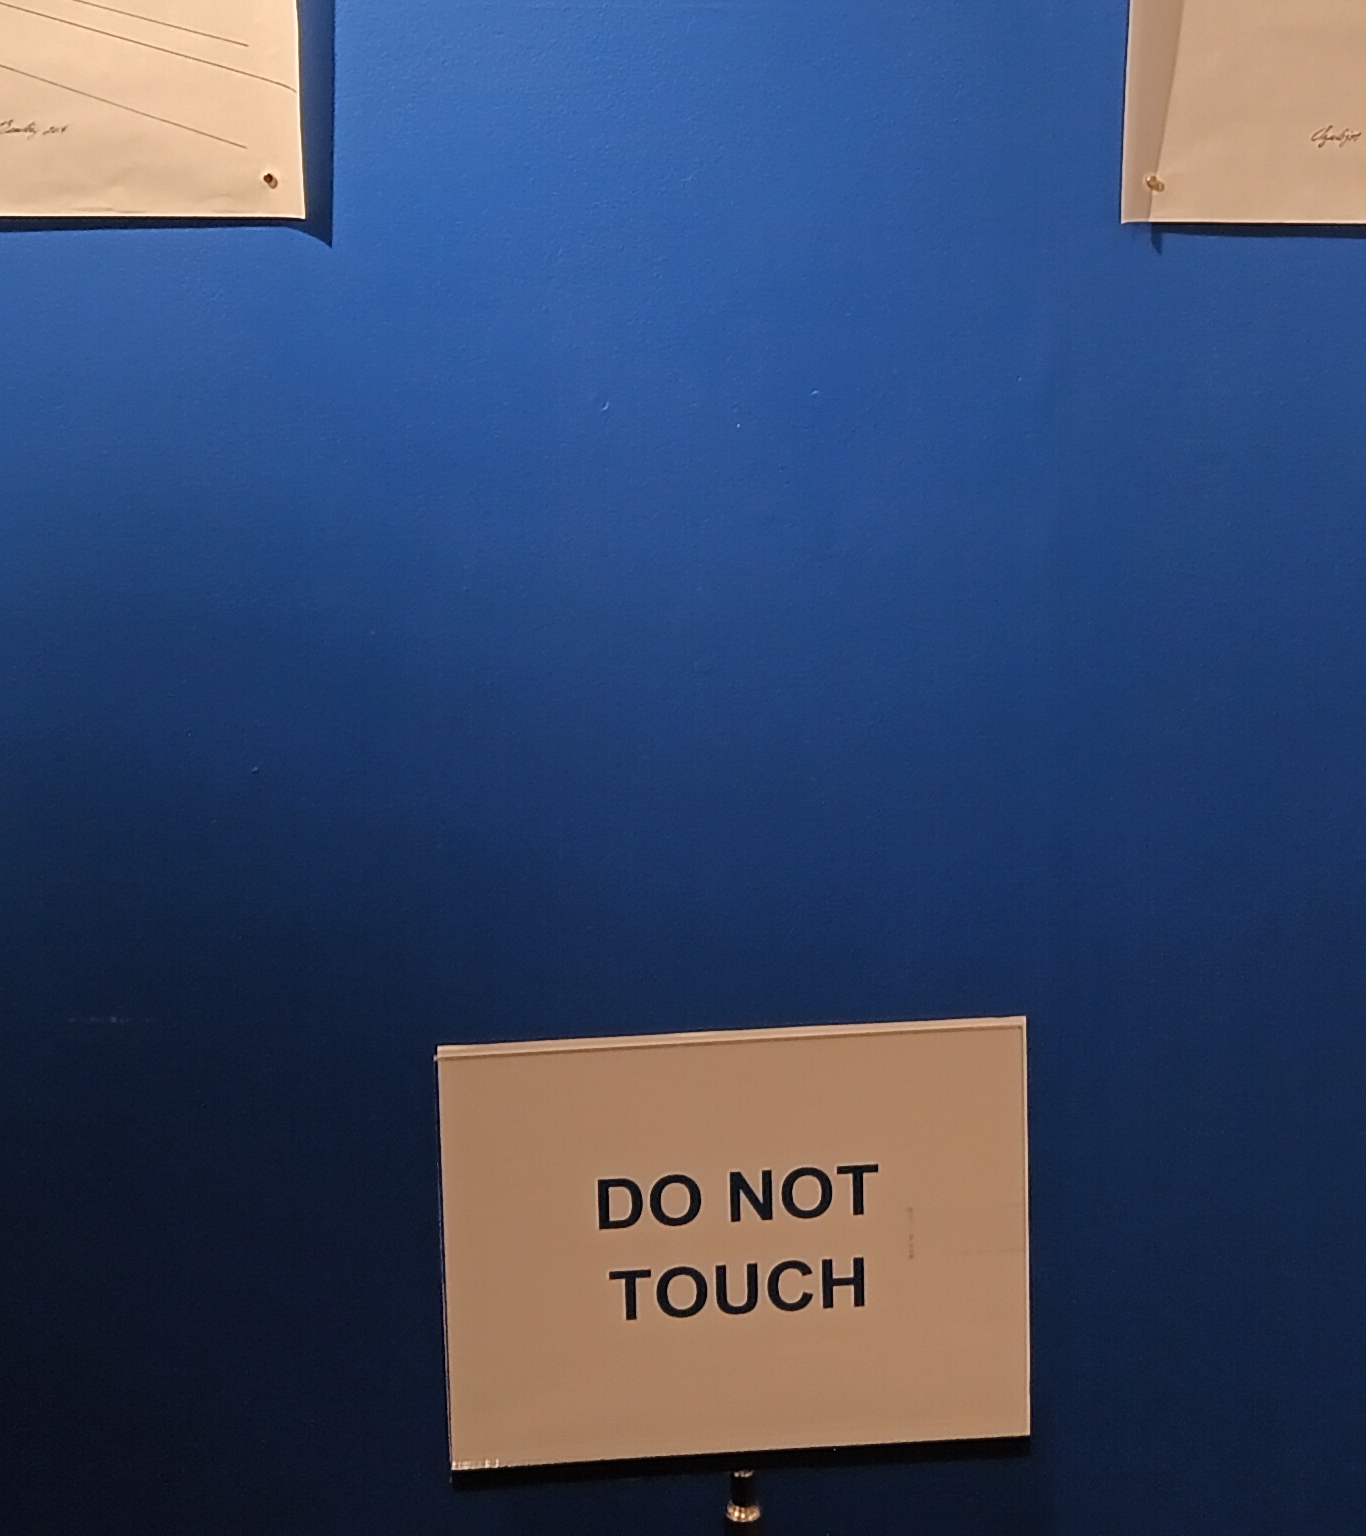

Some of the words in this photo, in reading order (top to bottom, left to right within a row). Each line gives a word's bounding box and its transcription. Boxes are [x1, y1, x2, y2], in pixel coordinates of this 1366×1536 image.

[597, 1174, 702, 1231] DO
[729, 1163, 879, 1223] NOT
[608, 1257, 865, 1321] TOUCH
